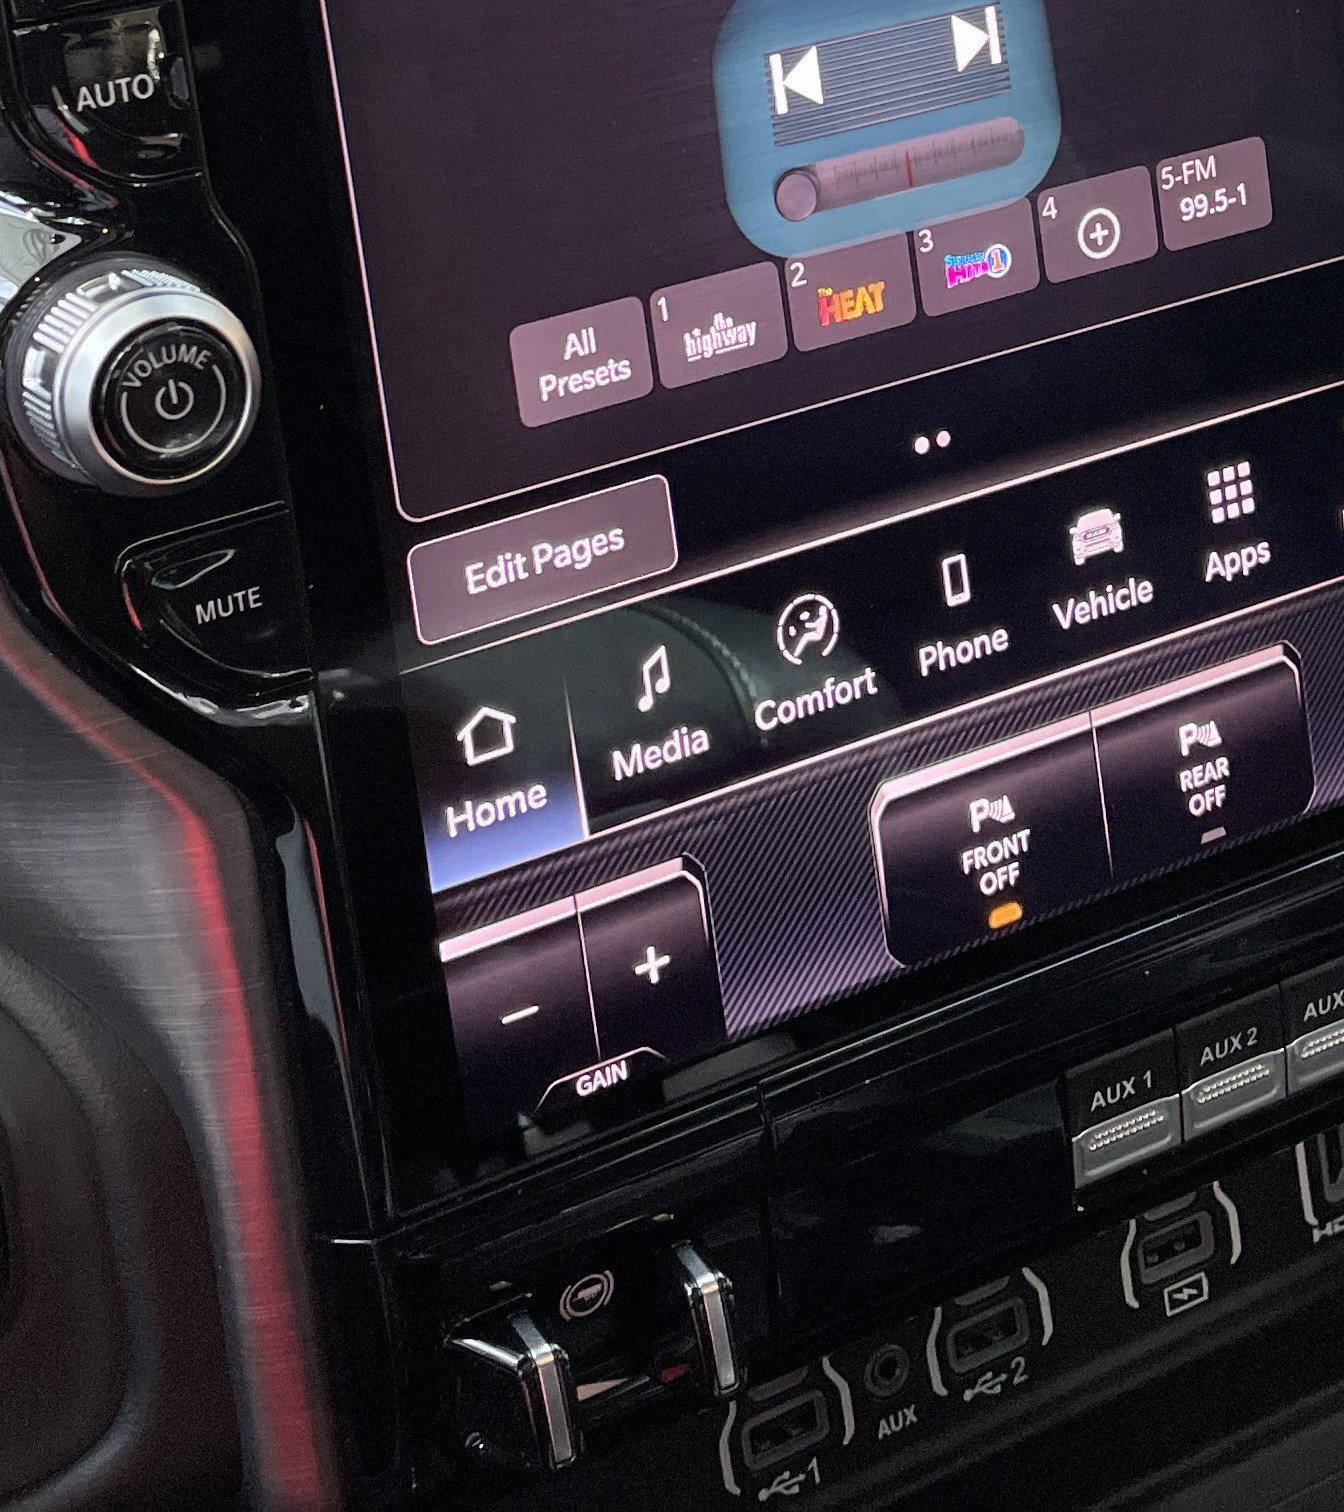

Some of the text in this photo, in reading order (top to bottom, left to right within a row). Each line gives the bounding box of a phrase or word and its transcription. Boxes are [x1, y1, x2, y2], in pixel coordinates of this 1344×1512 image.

[76, 73, 156, 112] AUTO
[1160, 156, 1218, 190] 5-FM
[1041, 196, 1058, 220] 4
[1179, 183, 1249, 222] 99.5-1
[918, 229, 934, 253] 3
[789, 261, 807, 288] 2
[657, 296, 669, 322] 1
[818, 280, 886, 327] HEAT
[563, 326, 596, 361] All
[683, 321, 757, 361] highway
[122, 343, 212, 389] VOLUME
[539, 358, 632, 402] Presets
[466, 528, 625, 594] Edit Pages
[1205, 541, 1271, 582] Apps
[195, 586, 263, 625] MUTE
[1053, 578, 1154, 629] Vehicle
[919, 627, 1009, 676] Phone
[754, 667, 878, 731] Comfort
[612, 727, 709, 781] Media
[1179, 756, 1230, 793] REAR
[446, 782, 548, 838] Home
[1188, 784, 1227, 817] OFF
[962, 829, 1031, 875] FRONT
[980, 861, 1020, 896] OFF
[1303, 993, 1344, 1022] AUX
[1199, 1027, 1259, 1066] AUX 2
[576, 1060, 627, 1096] GAIN
[1090, 1069, 1154, 1112] AUX 1
[1010, 1356, 1029, 1386] 2
[877, 1404, 919, 1439] AUX
